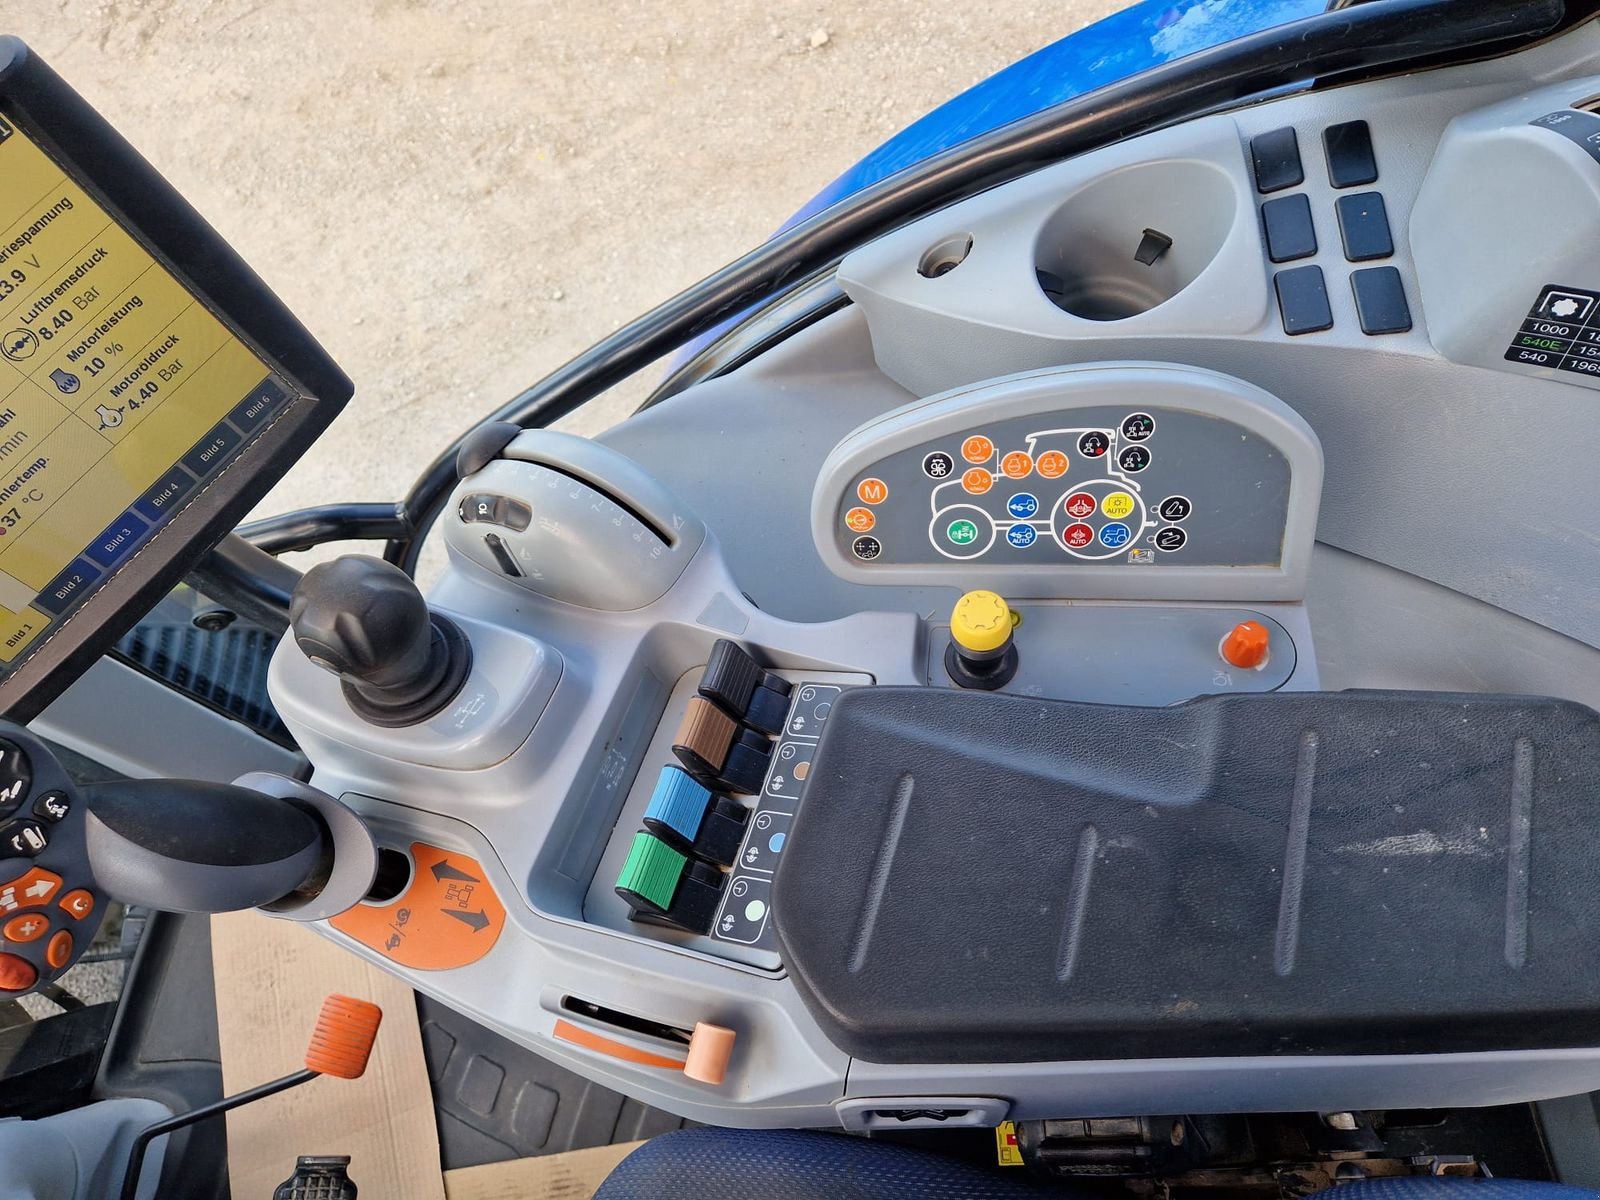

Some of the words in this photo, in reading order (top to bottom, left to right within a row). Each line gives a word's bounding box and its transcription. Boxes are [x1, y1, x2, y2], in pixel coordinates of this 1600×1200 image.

[23, 254, 40, 268] V
[20, 247, 108, 325] Luftbremsdruck
[39, 309, 73, 340] 8.40
[72, 286, 100, 311] Bar
[66, 295, 143, 362] Motorleistung
[1533, 323, 1569, 335] 1000
[1519, 351, 1548, 362] 540
[1521, 336, 1562, 350] 540E
[1580, 346, 1600, 356] 15
[84, 357, 105, 377] 10
[104, 342, 124, 357] %
[109, 333, 180, 398] Motoröldruck
[60, 376, 77, 392] kW
[128, 381, 159, 410] 4.40
[157, 359, 183, 382] Bar
[246, 402, 264, 418] Bild
[262, 395, 270, 403] 6
[0, 431, 28, 460] min
[200, 445, 218, 462] Bild
[216, 438, 225, 447] 5
[152, 490, 172, 507] Bild
[864, 485, 881, 499] M
[3, 507, 21, 527] 37
[22, 489, 44, 503] °C
[105, 534, 125, 552] Bild
[122, 528, 131, 536] 3
[650, 546, 662, 560] 10
[56, 582, 76, 599] Bild
[73, 575, 82, 583] 2
[6, 629, 26, 647] Bild
